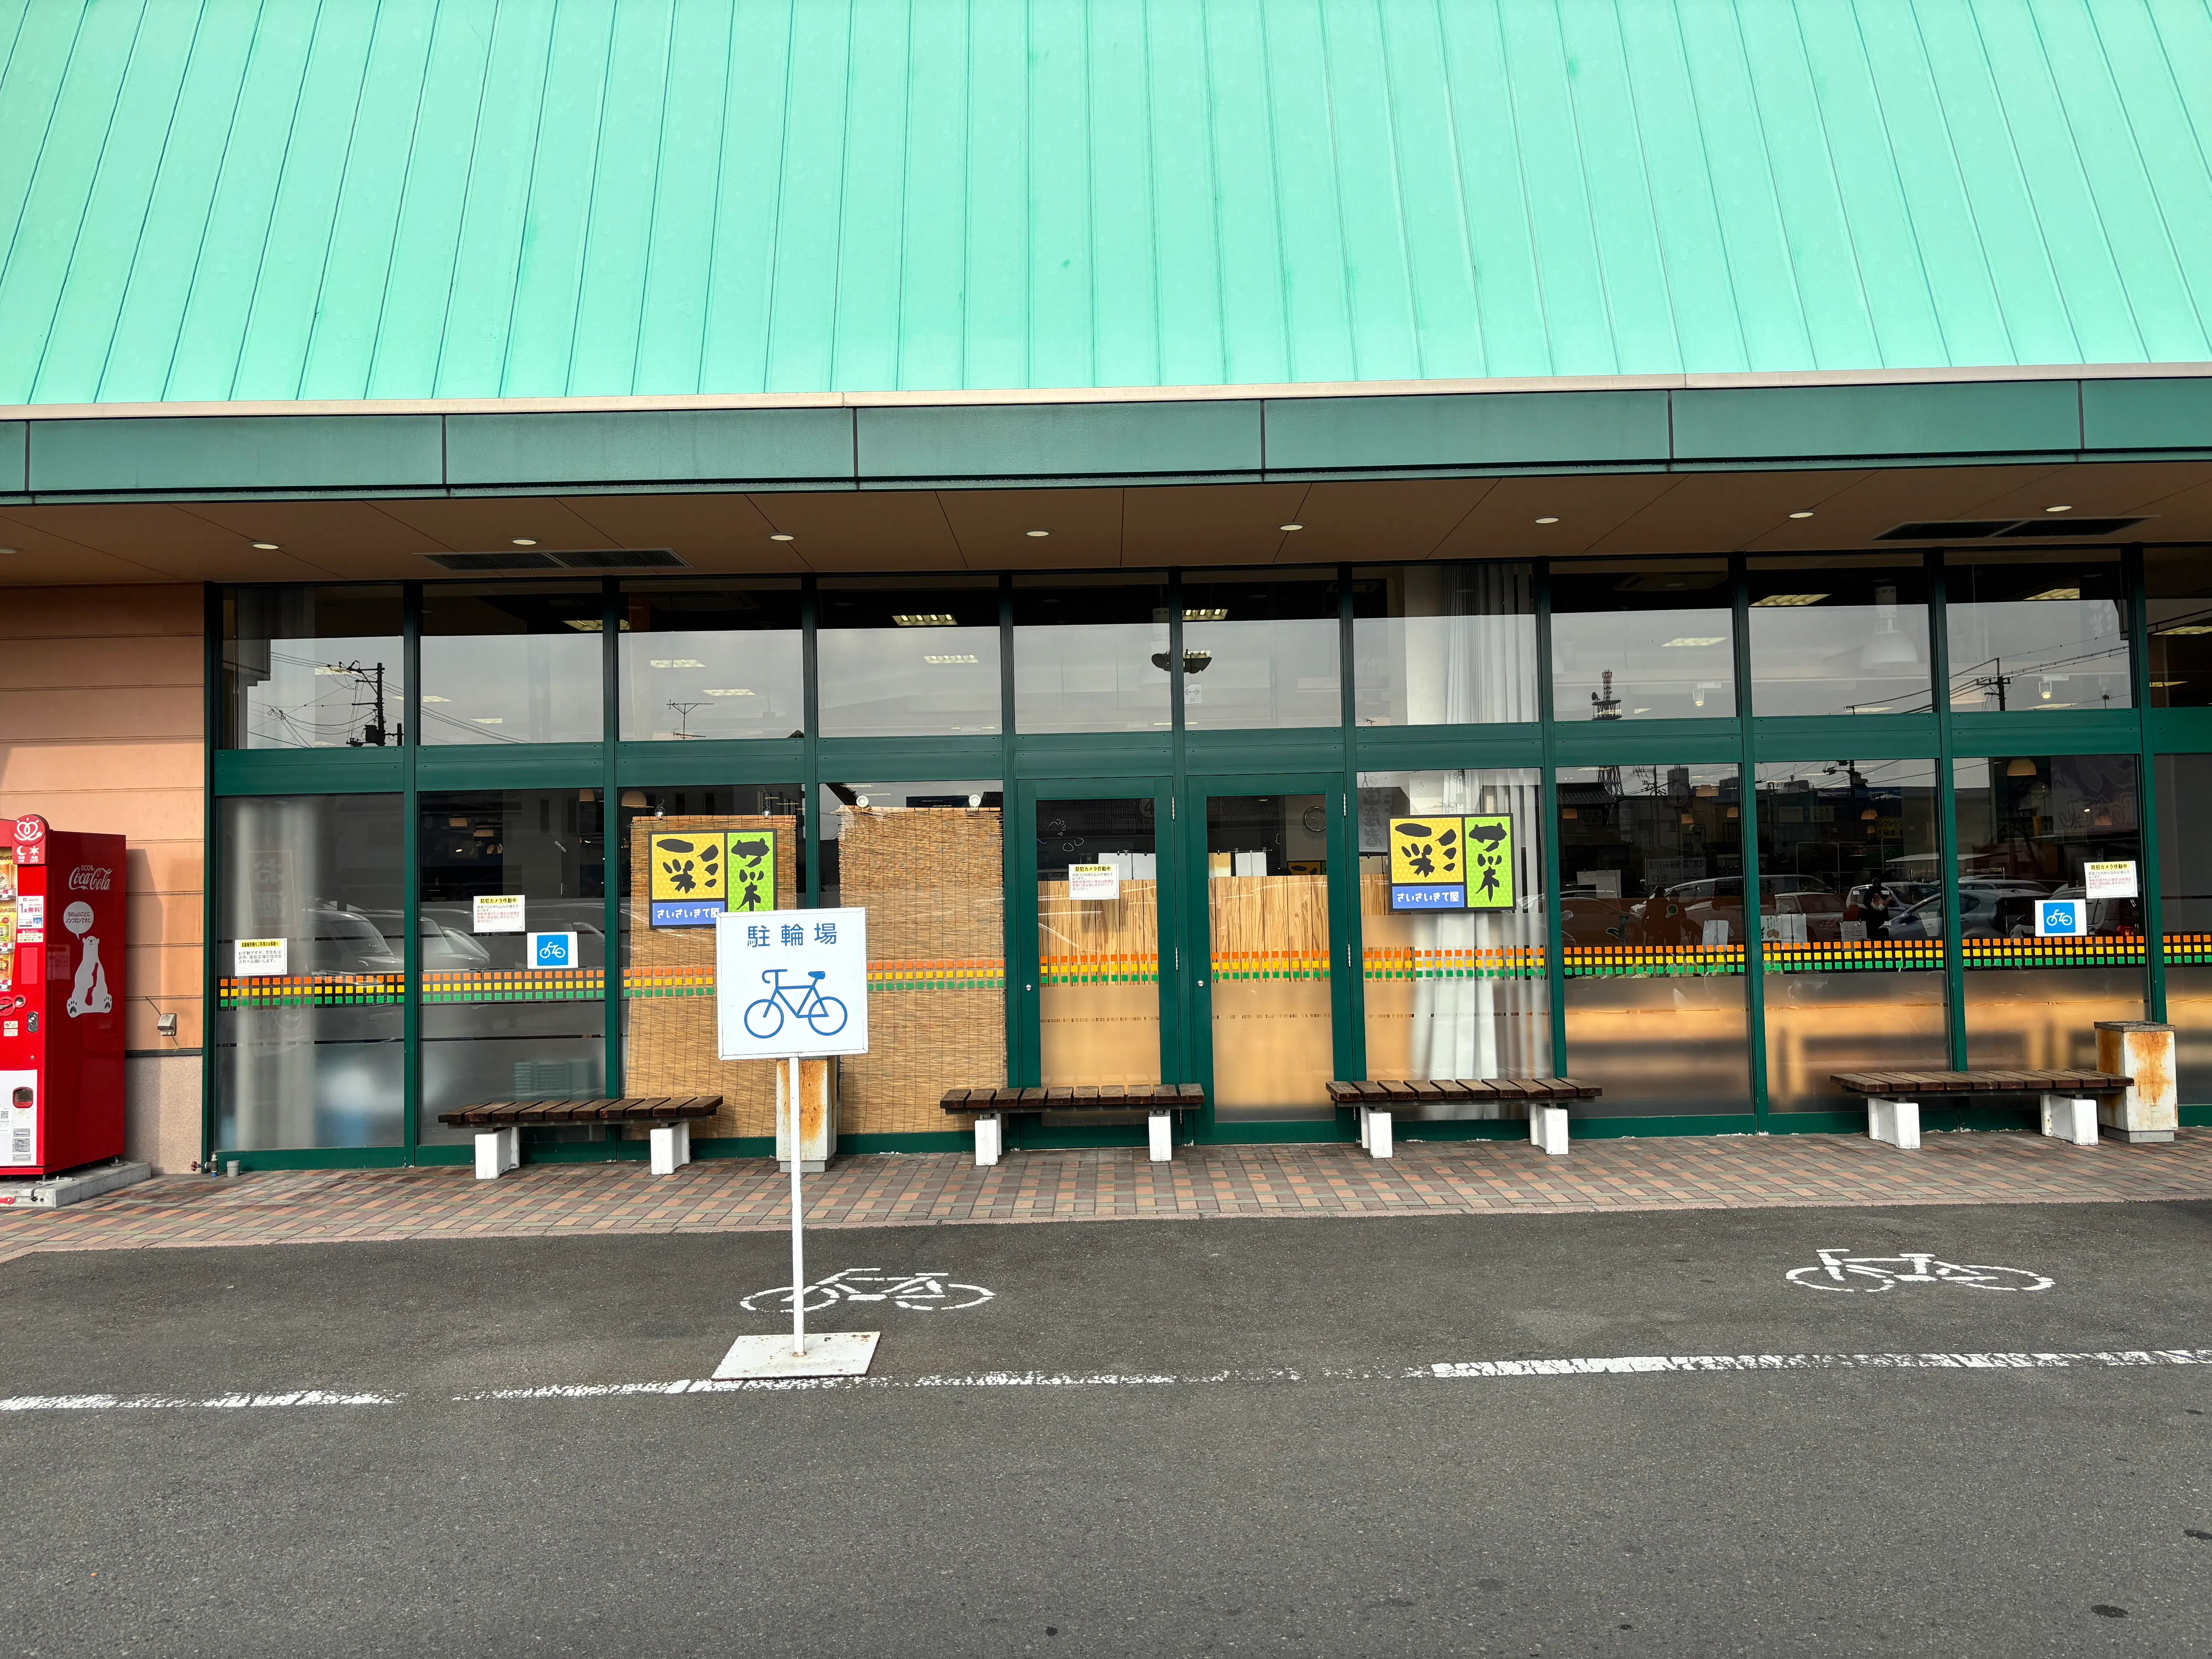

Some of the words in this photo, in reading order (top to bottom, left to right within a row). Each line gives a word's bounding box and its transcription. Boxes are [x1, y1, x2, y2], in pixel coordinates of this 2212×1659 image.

[1397, 891, 1459, 902] さいさいきて屋
[657, 908, 720, 919] さいさいきて屋
[747, 923, 837, 948] 駐輪場
